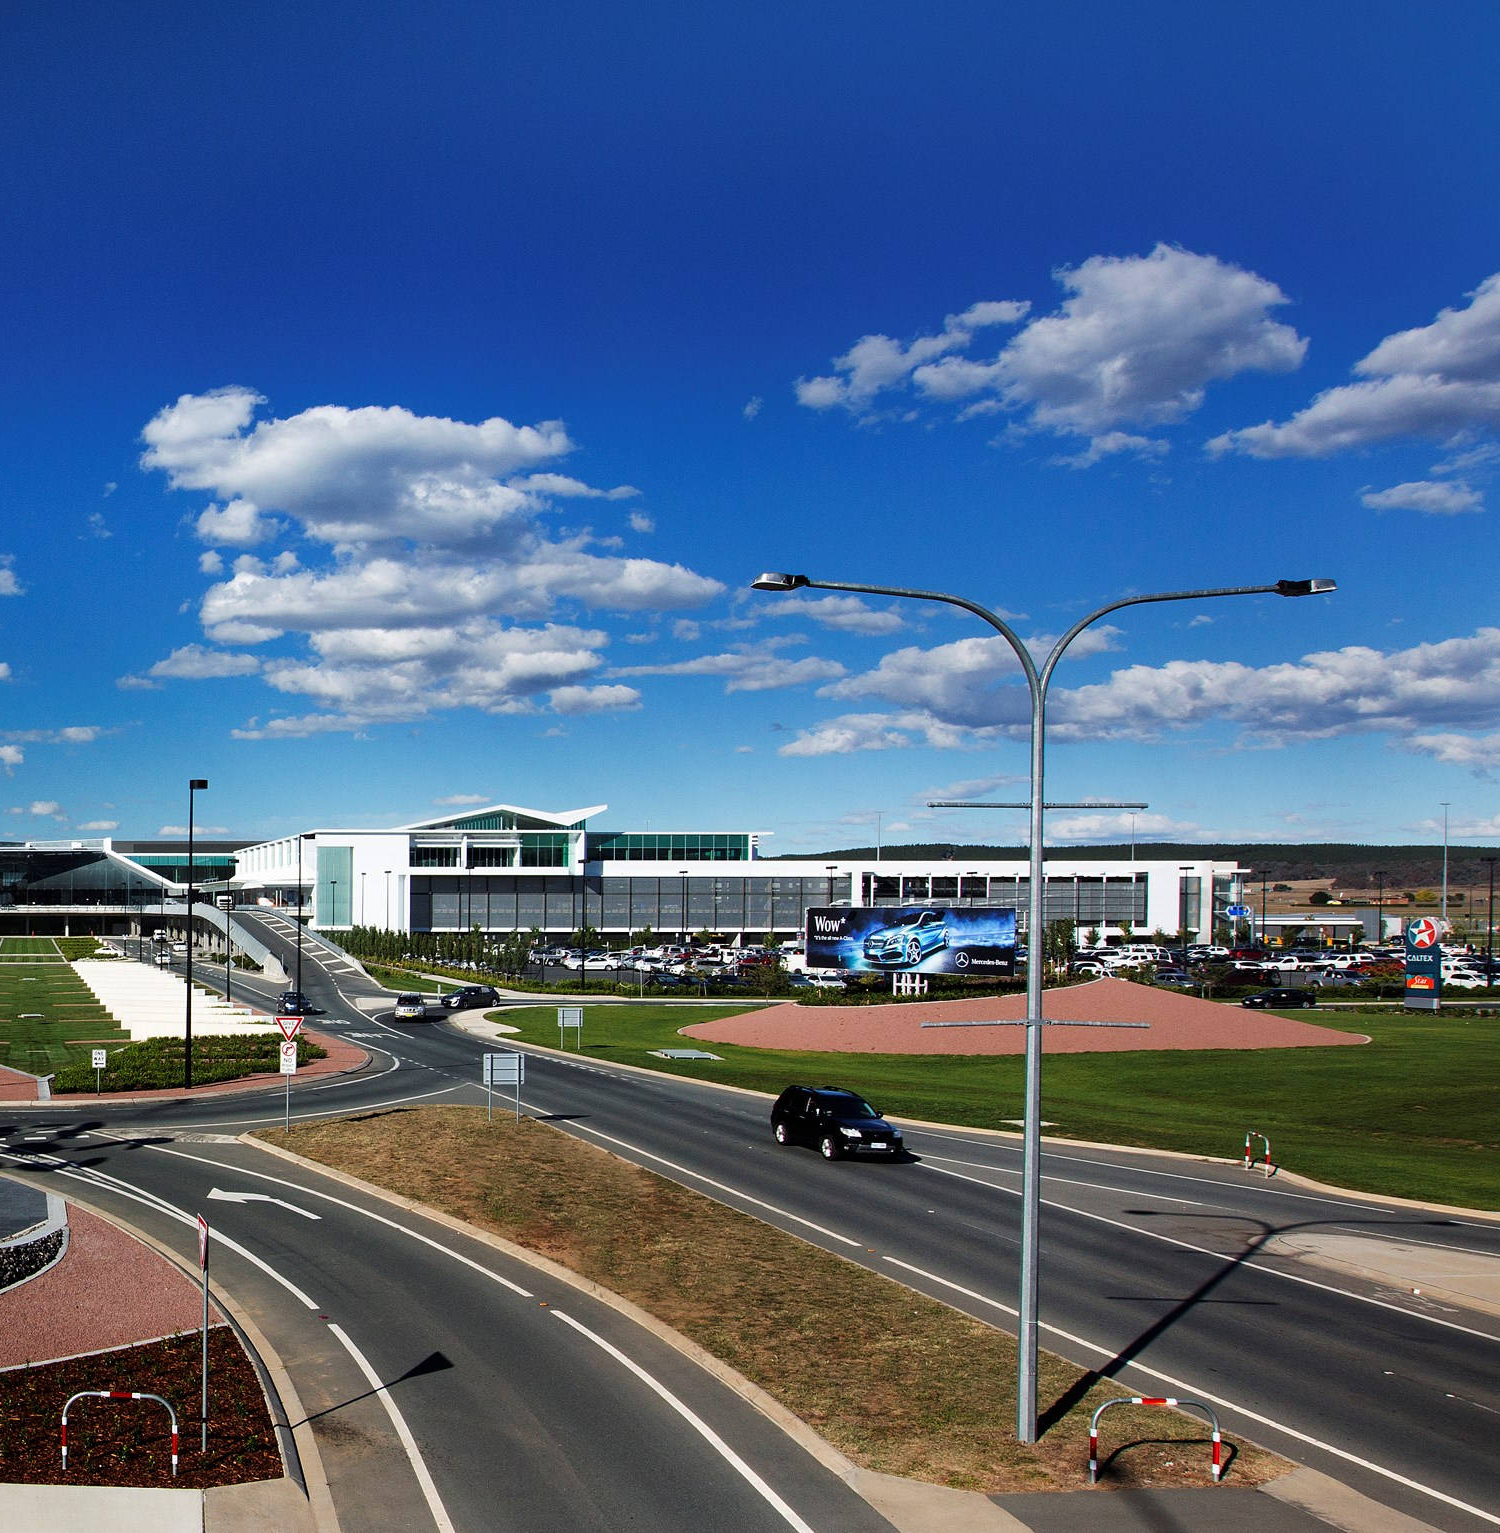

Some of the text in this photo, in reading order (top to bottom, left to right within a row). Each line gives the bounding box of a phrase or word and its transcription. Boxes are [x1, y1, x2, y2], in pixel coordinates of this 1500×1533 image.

[971, 958, 1009, 966] Mercedes-Benz
[1406, 954, 1434, 962] CALTEX
[1414, 975, 1427, 985] Star
